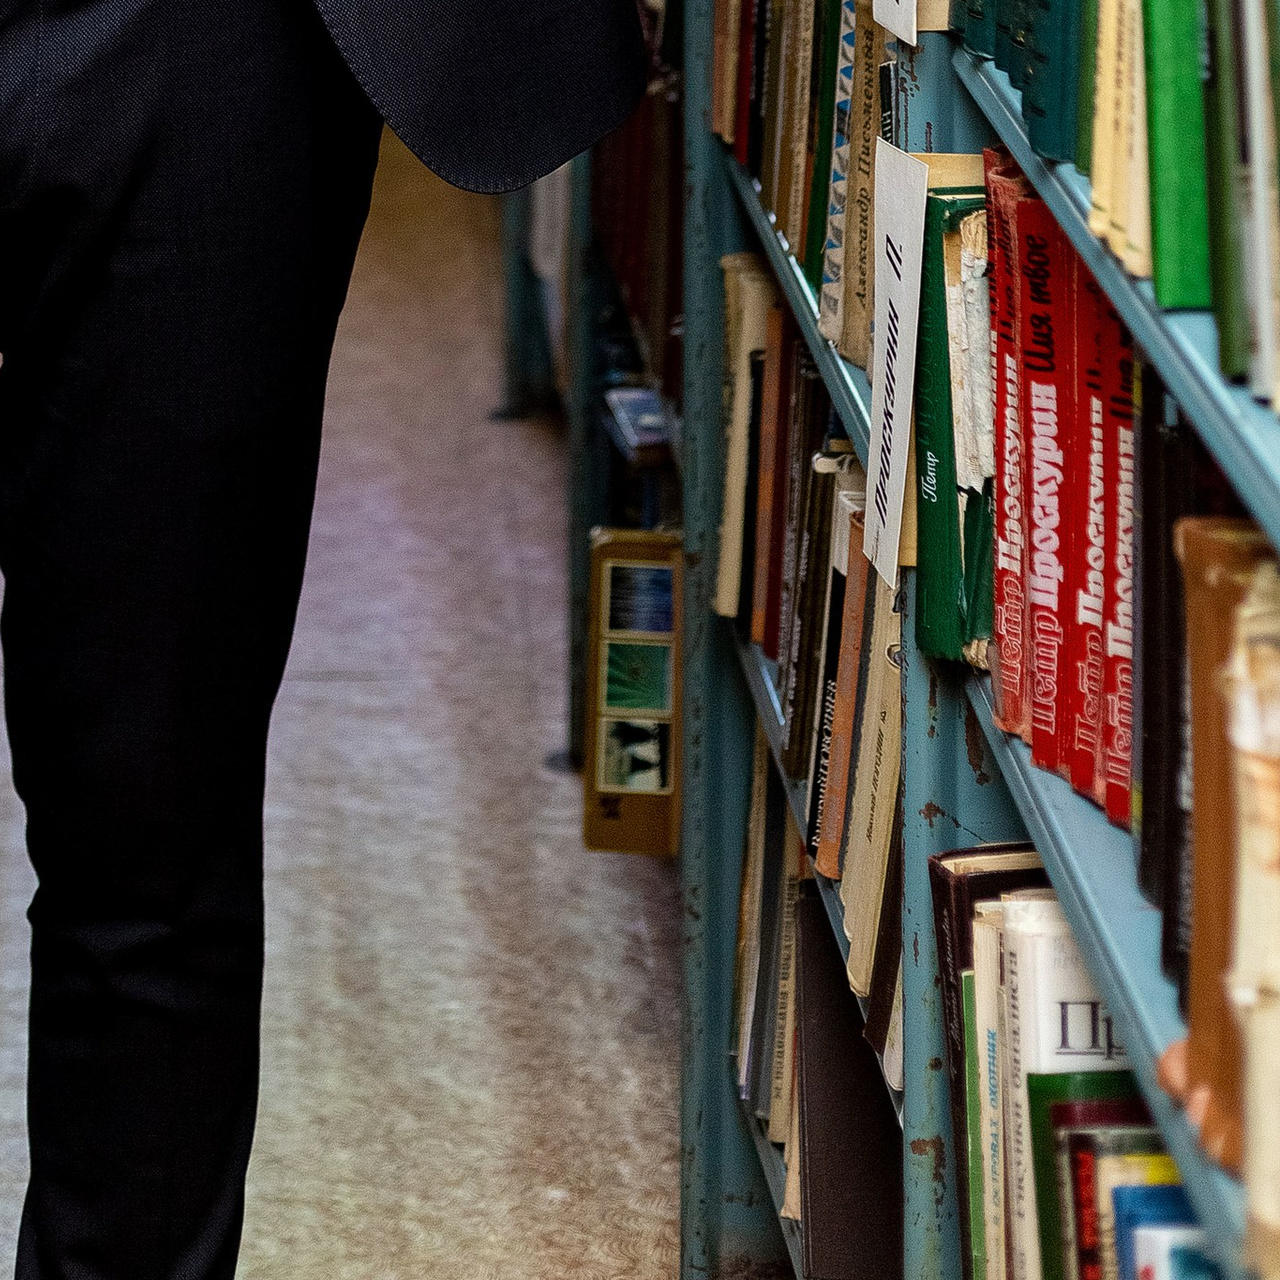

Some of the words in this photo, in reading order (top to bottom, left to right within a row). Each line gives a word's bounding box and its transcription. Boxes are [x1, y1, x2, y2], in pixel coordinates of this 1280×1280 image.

[856, 28, 876, 178] Письменный
[855, 187, 871, 310] Александр
[885, 233, 903, 282] П.
[874, 297, 899, 529] Проскурин
[997, 352, 1024, 577] Проскурин
[1028, 379, 1064, 612] Проскурин
[1076, 396, 1106, 629] Проскурин
[1107, 425, 1134, 660] Проскурин
[986, 1027, 998, 1110] ОХОТНИК
